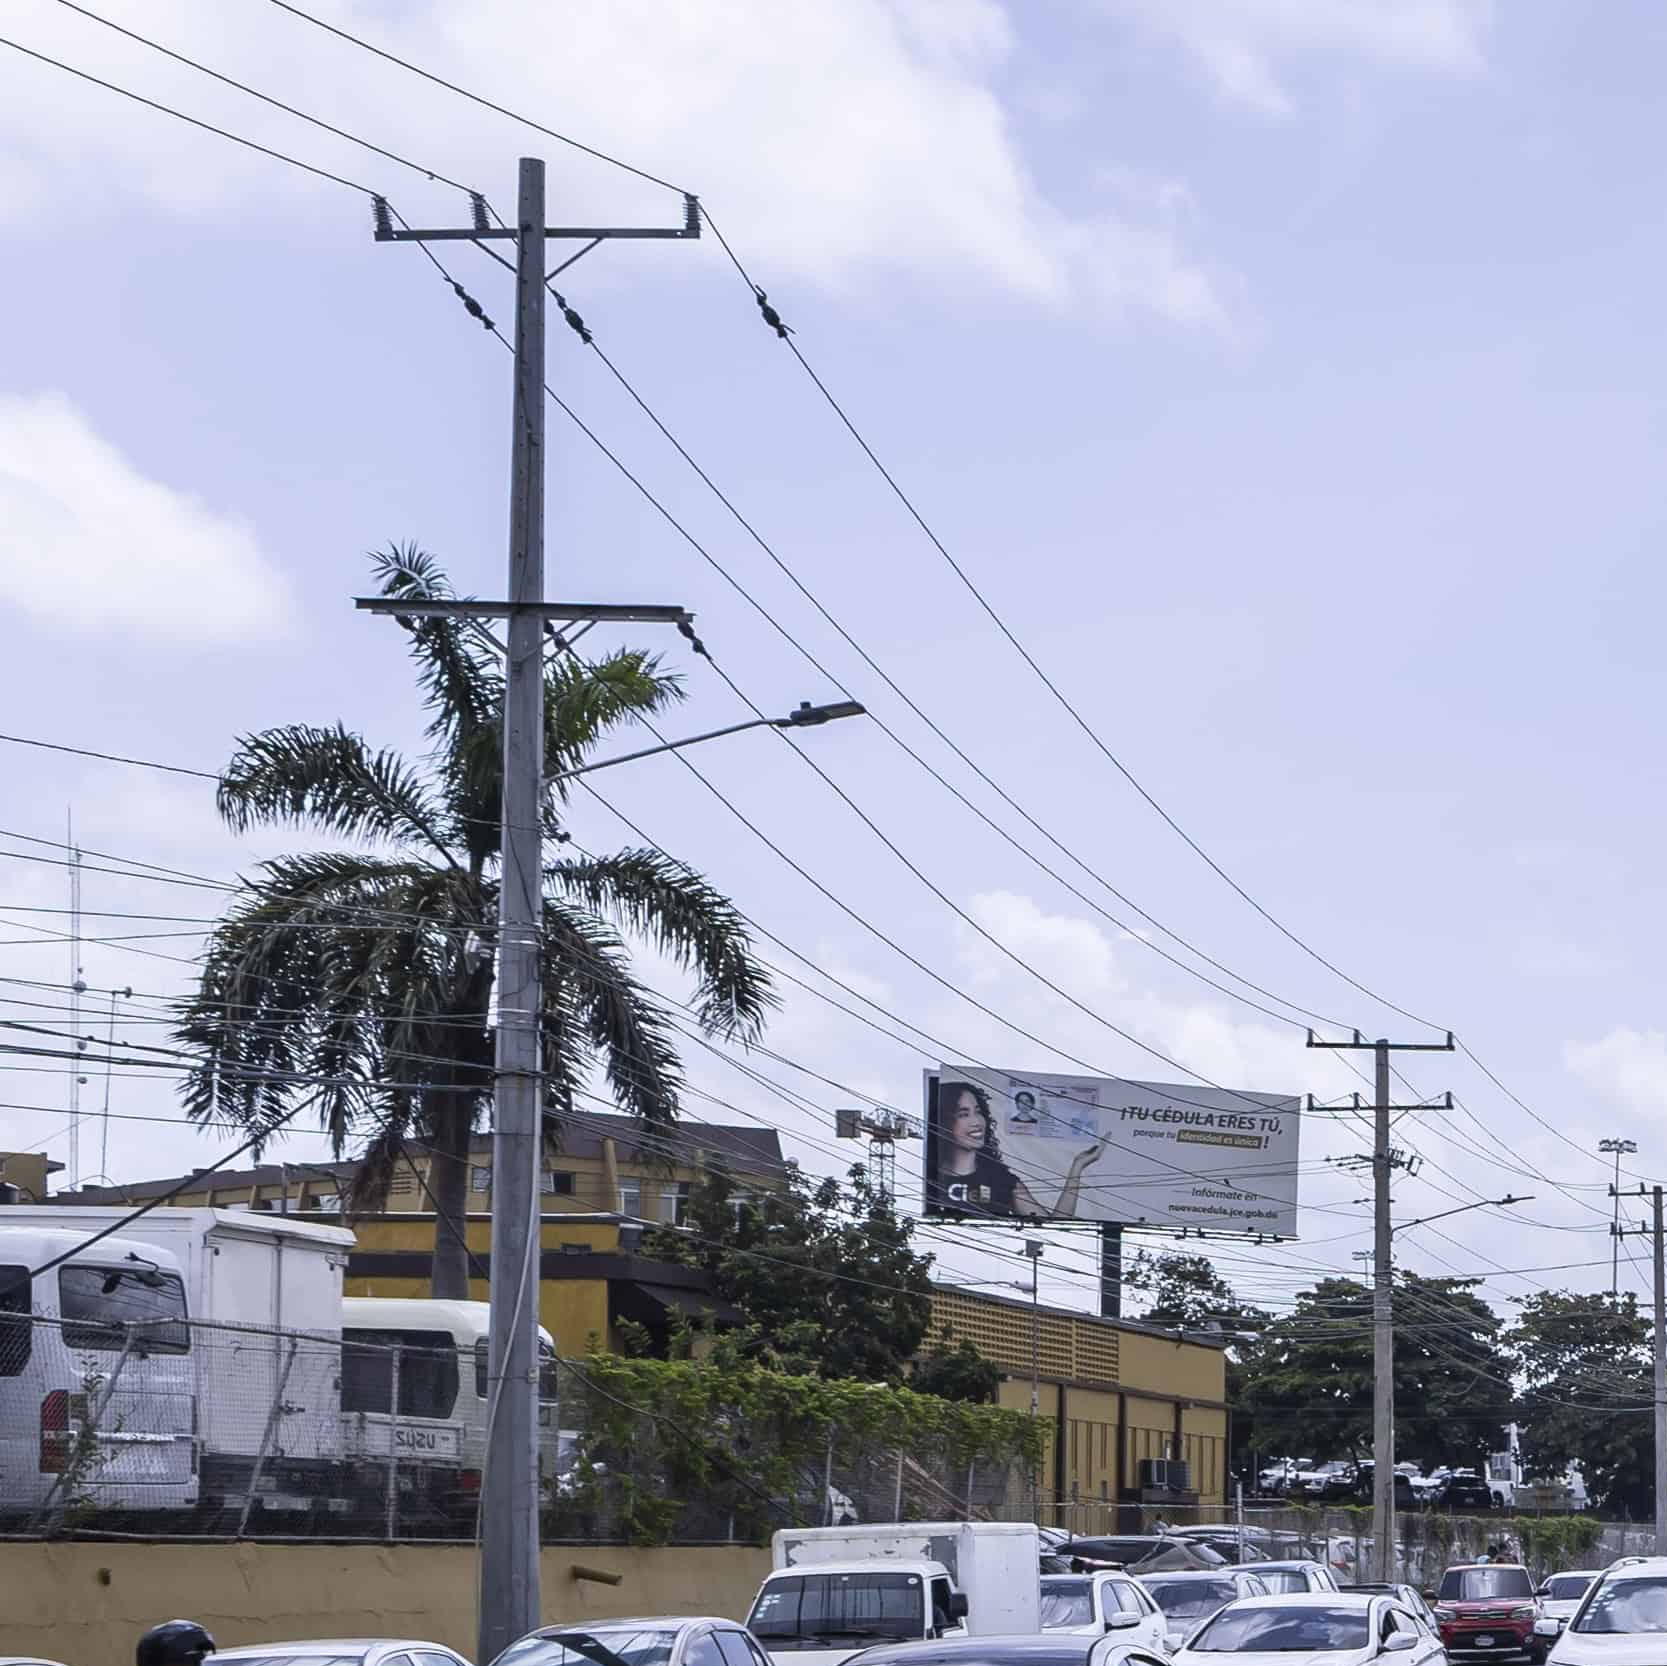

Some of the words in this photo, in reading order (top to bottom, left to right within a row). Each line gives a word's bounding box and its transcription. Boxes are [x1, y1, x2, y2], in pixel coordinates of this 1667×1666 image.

[1152, 1105, 1214, 1128] CÉDULA
[1217, 1115, 1257, 1130] ERES
[1259, 1117, 1284, 1136] TÚ,
[1133, 1129, 1165, 1137] porque
